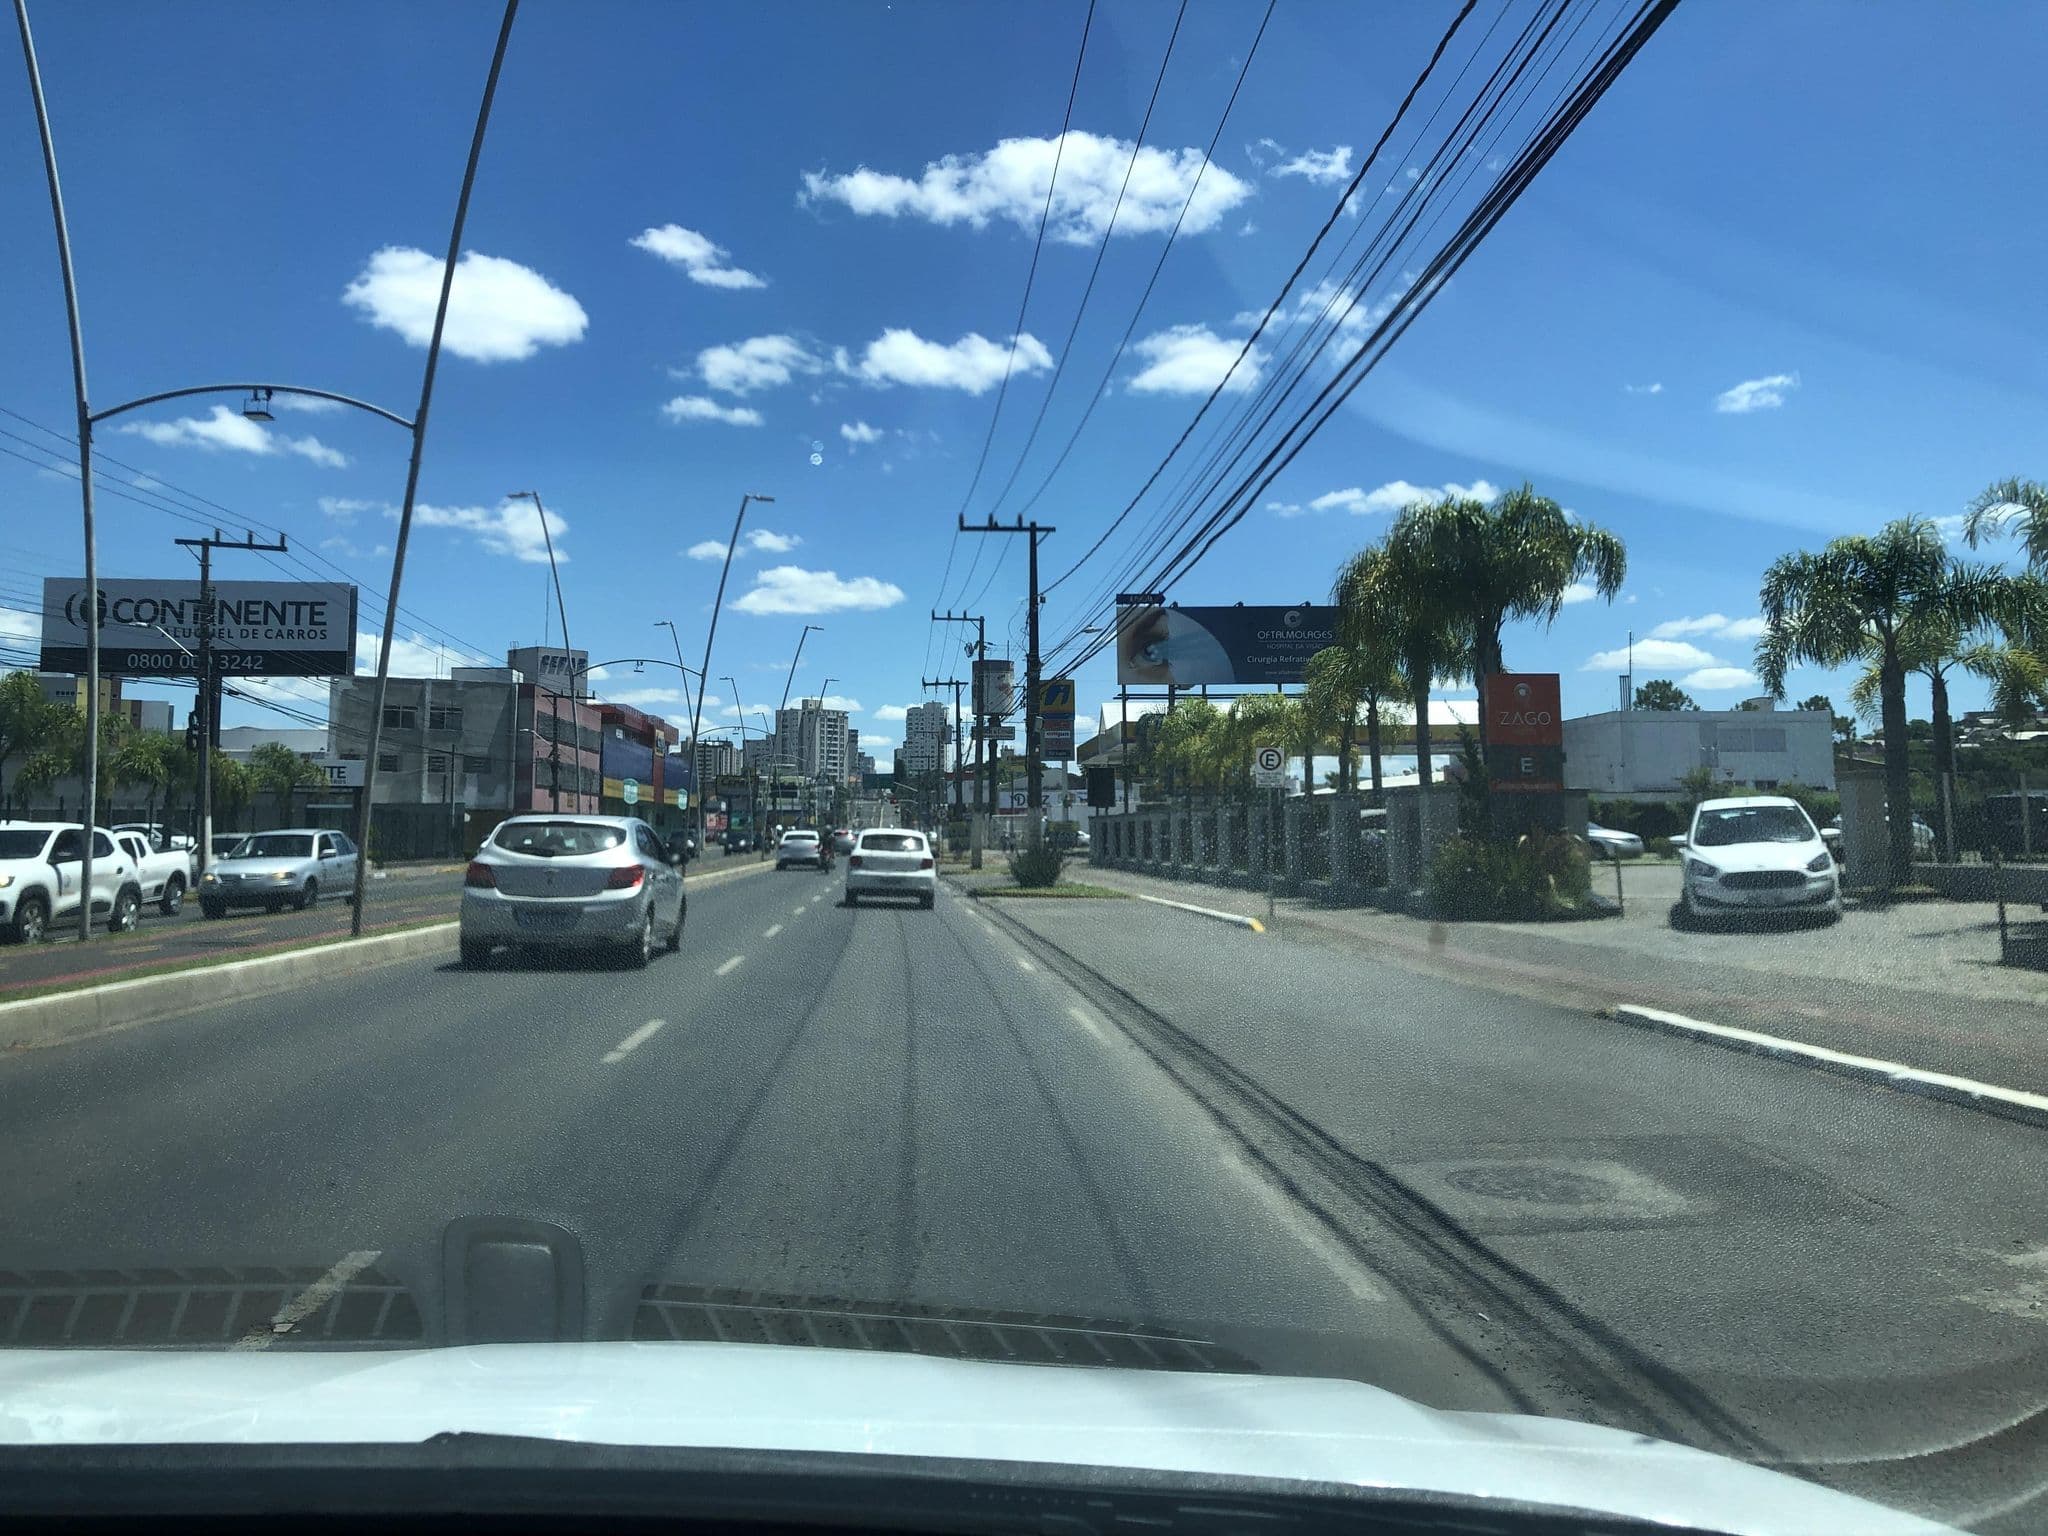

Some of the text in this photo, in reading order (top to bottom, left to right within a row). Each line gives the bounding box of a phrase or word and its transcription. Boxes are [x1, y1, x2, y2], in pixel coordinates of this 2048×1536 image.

[112, 597, 328, 626] CONTNENTE
[240, 628, 259, 639] DE
[263, 628, 328, 640] CARROS
[1257, 630, 1333, 640] OFTALMOLAGES
[127, 653, 264, 670] 0800 00 3242
[1246, 655, 1278, 665] Cirurgia
[1500, 711, 1552, 726] ZAGO
[1265, 753, 1275, 767] E
[1520, 757, 1535, 773] E
